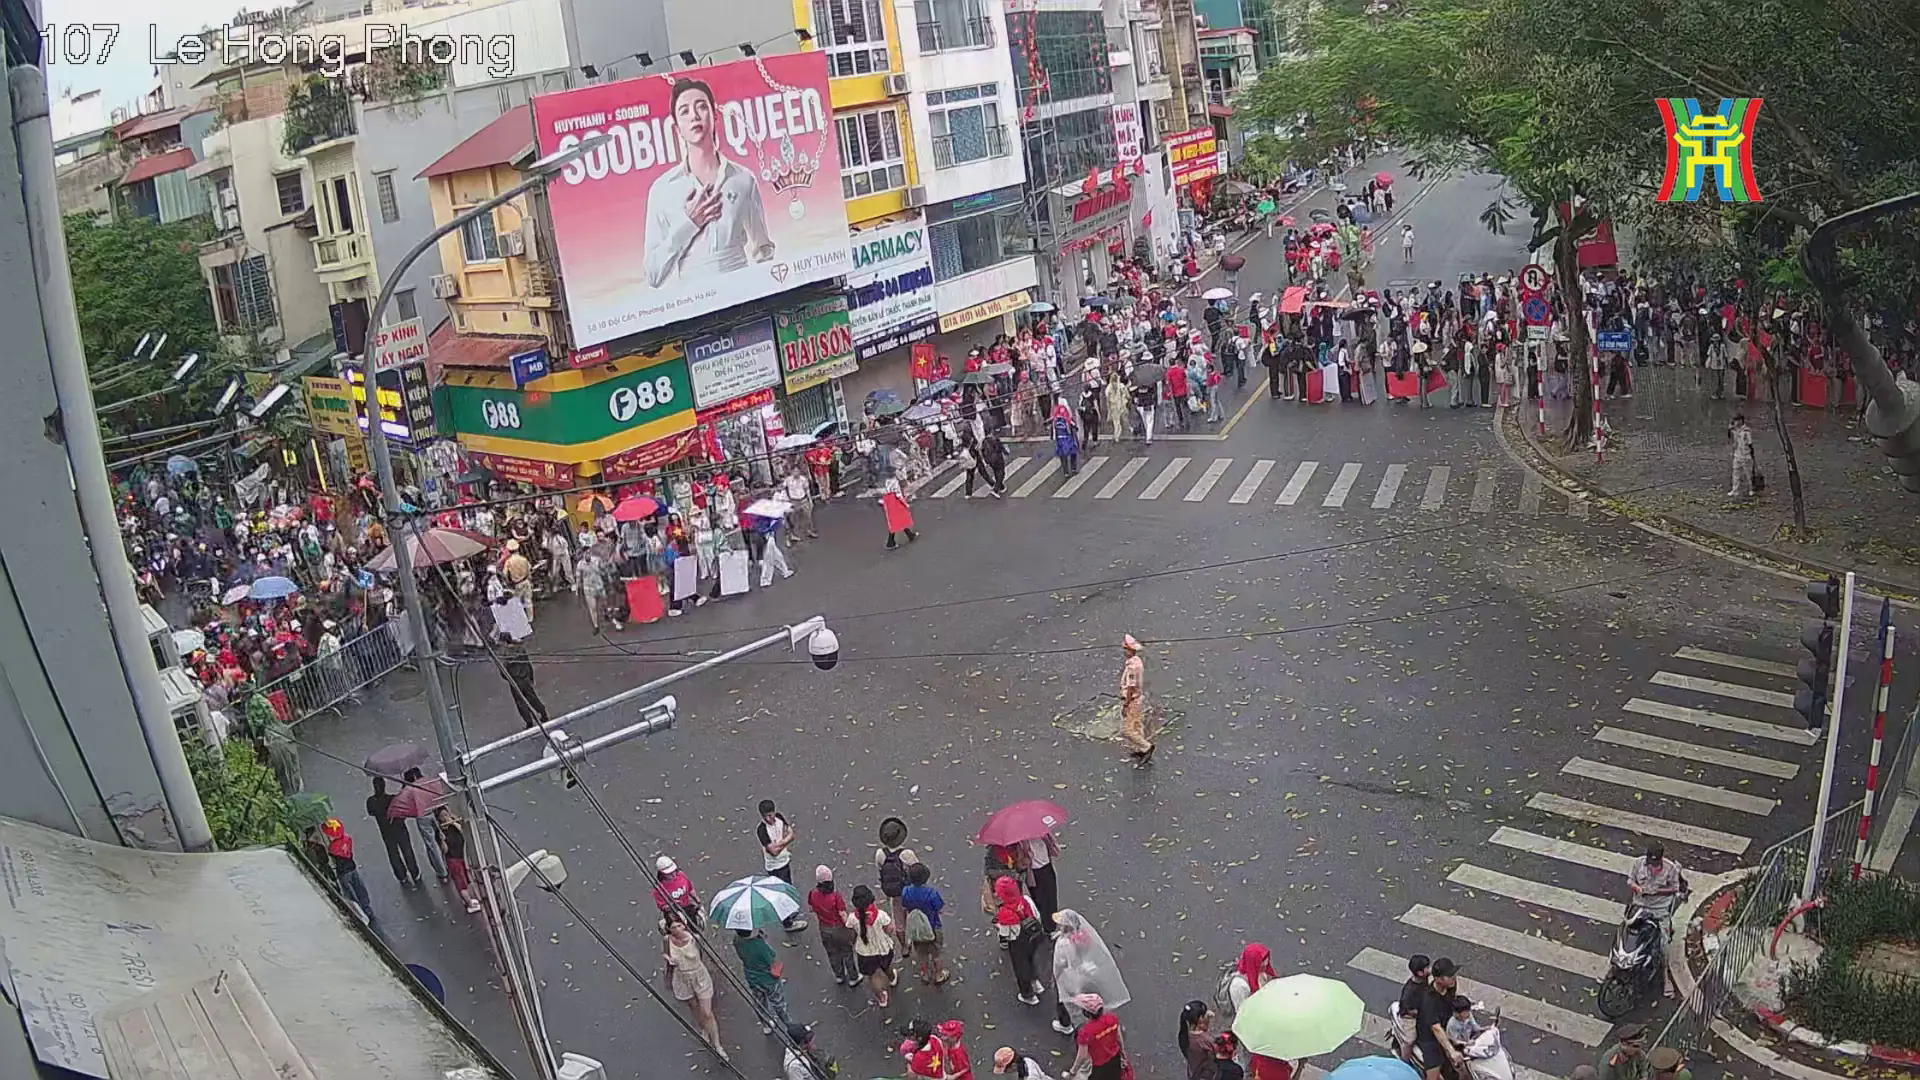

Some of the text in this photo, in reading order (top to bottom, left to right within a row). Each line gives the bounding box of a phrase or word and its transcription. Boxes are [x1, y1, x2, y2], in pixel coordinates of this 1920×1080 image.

[554, 112, 606, 134] HUYTHANH
[615, 104, 650, 121] SOOBIN
[559, 88, 825, 185] SOOBIN QUEEN
[793, 257, 812, 273] HUY
[814, 248, 847, 266] THANH
[398, 342, 425, 361] NGAY
[529, 362, 544, 373] MB
[609, 375, 675, 422] F88
[482, 399, 521, 429] F88
